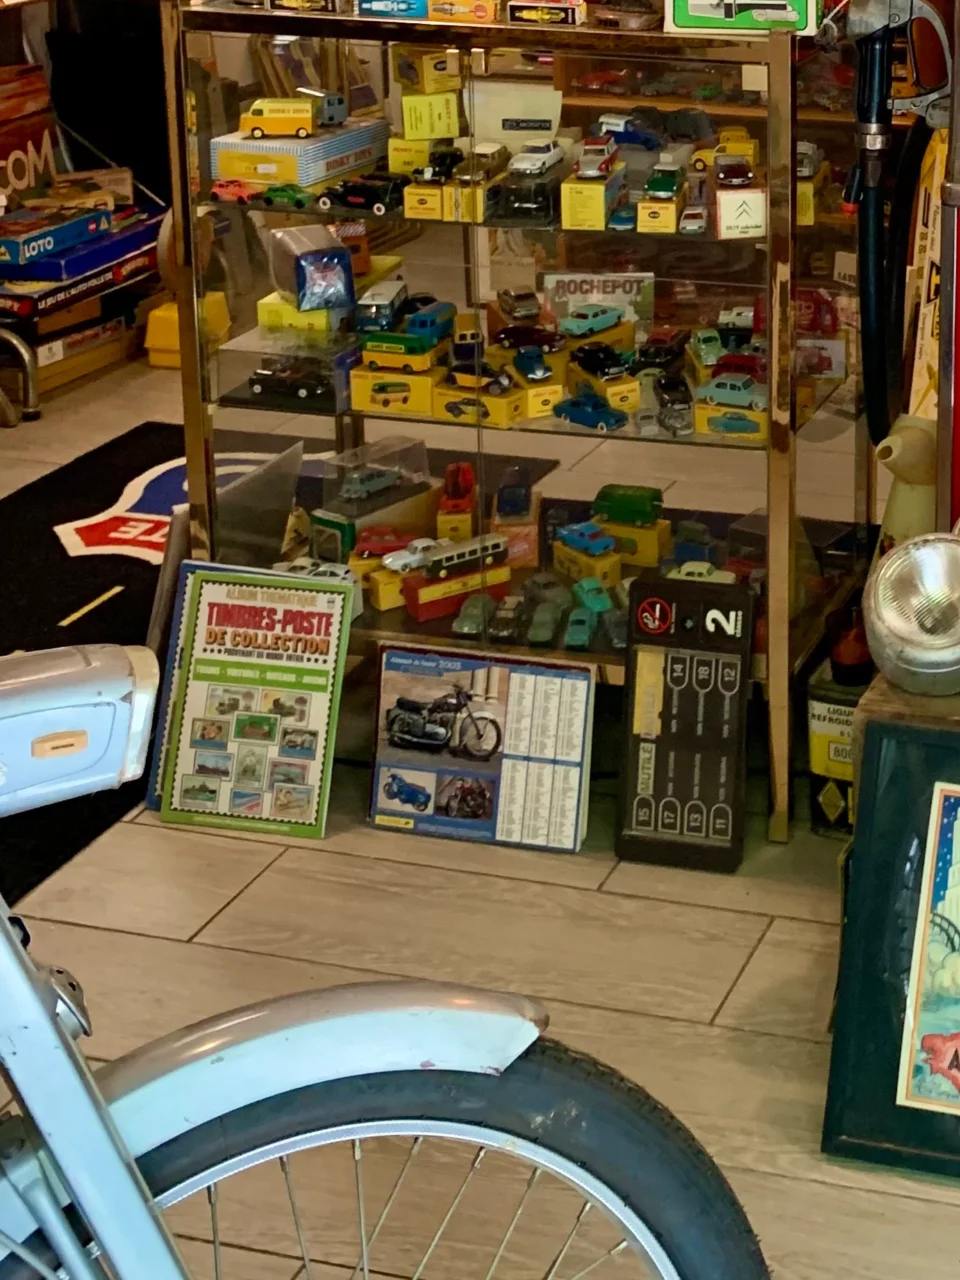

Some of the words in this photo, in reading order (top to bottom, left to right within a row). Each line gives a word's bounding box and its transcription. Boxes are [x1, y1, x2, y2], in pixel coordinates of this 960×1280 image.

[24, 236, 54, 258] LOTO
[555, 279, 644, 295] ROCHEPOT
[207, 602, 333, 638] TIMBRES-POSTE
[705, 608, 736, 637] 2
[205, 627, 228, 646] DE
[230, 630, 330, 656] COLLECTION
[673, 663, 684, 678] 14
[724, 668, 735, 682] 12
[638, 807, 650, 820] 15
[663, 810, 675, 823] 17
[689, 814, 701, 827] 13
[715, 816, 726, 829] 11
